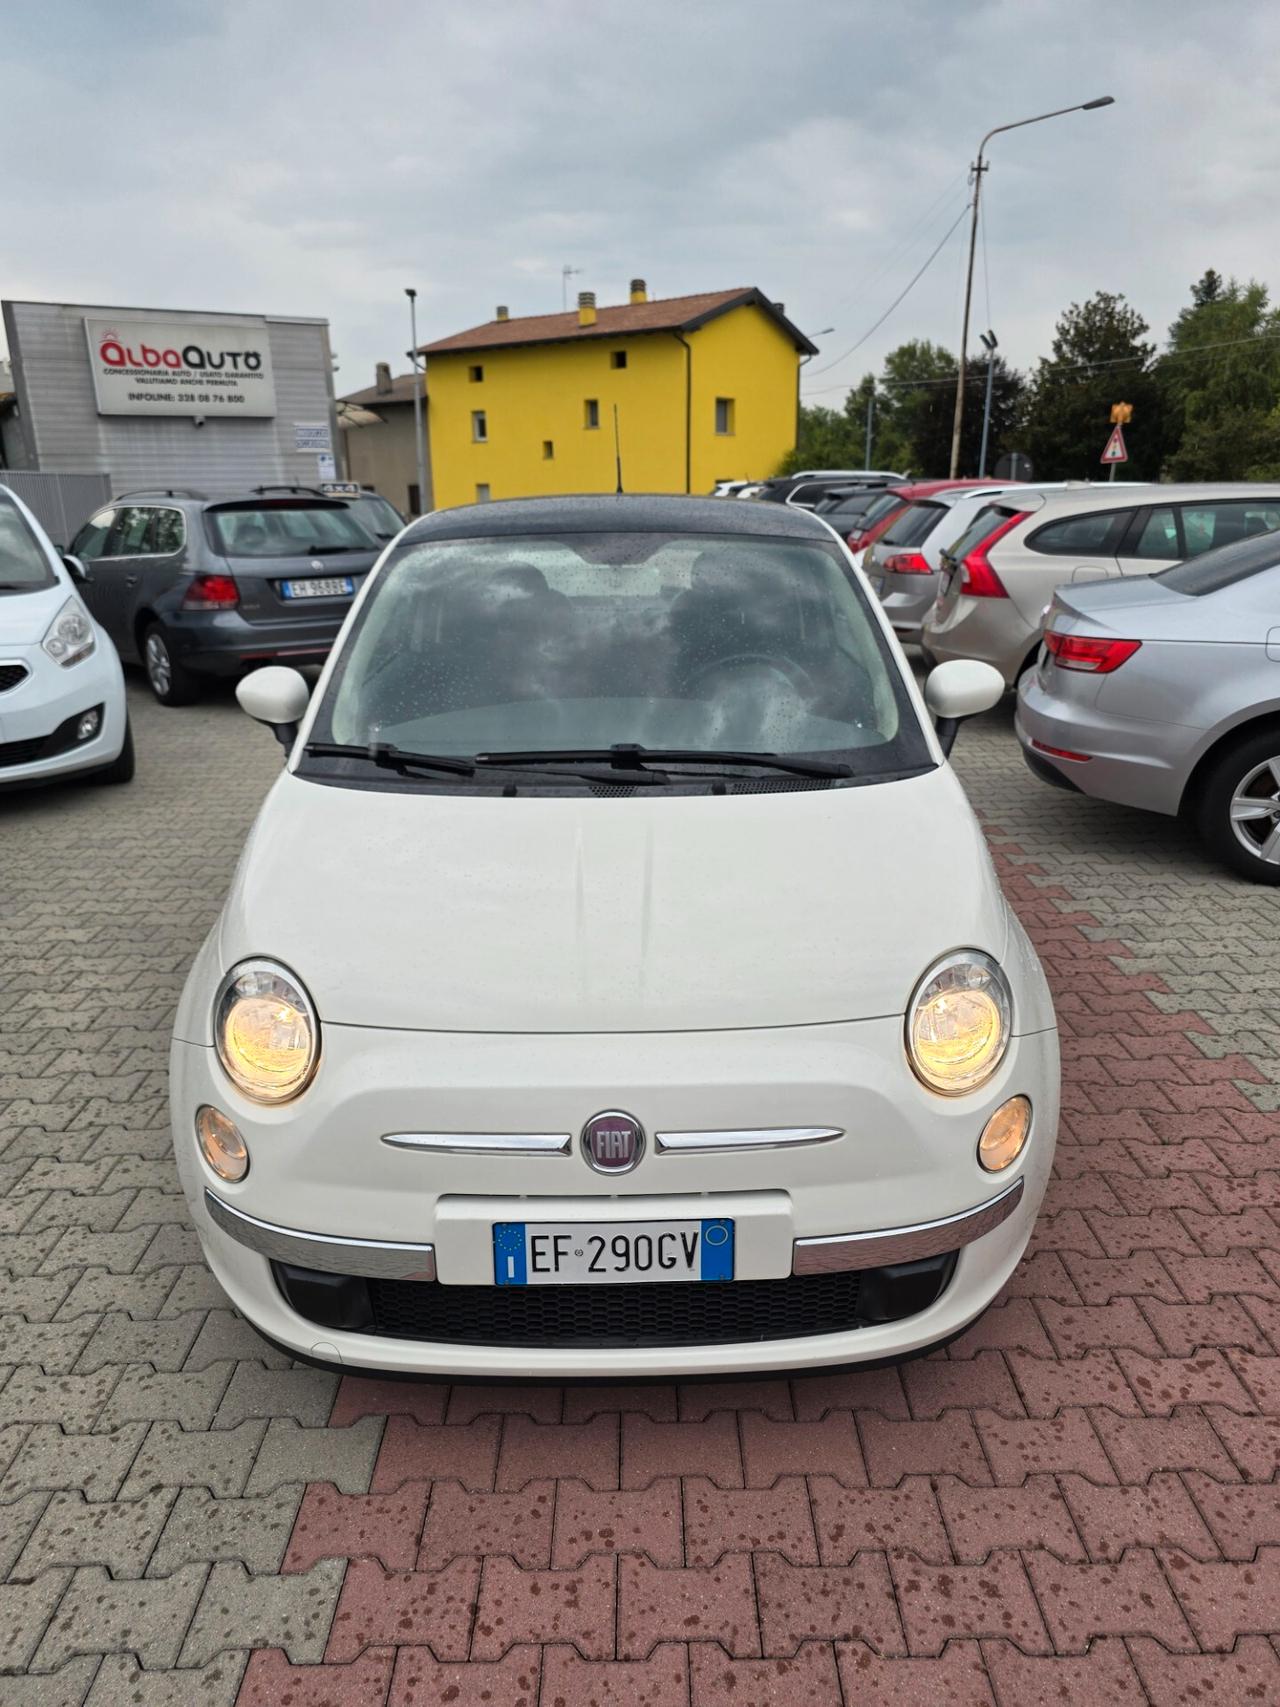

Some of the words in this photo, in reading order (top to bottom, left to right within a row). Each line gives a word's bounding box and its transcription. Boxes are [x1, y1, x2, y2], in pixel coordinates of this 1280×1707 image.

[103, 368, 169, 376] CONCESSIONARIA
[134, 377, 178, 385] VALUTIAMO
[128, 392, 176, 401] INFOLINE:
[596, 1131, 632, 1159] FIAT
